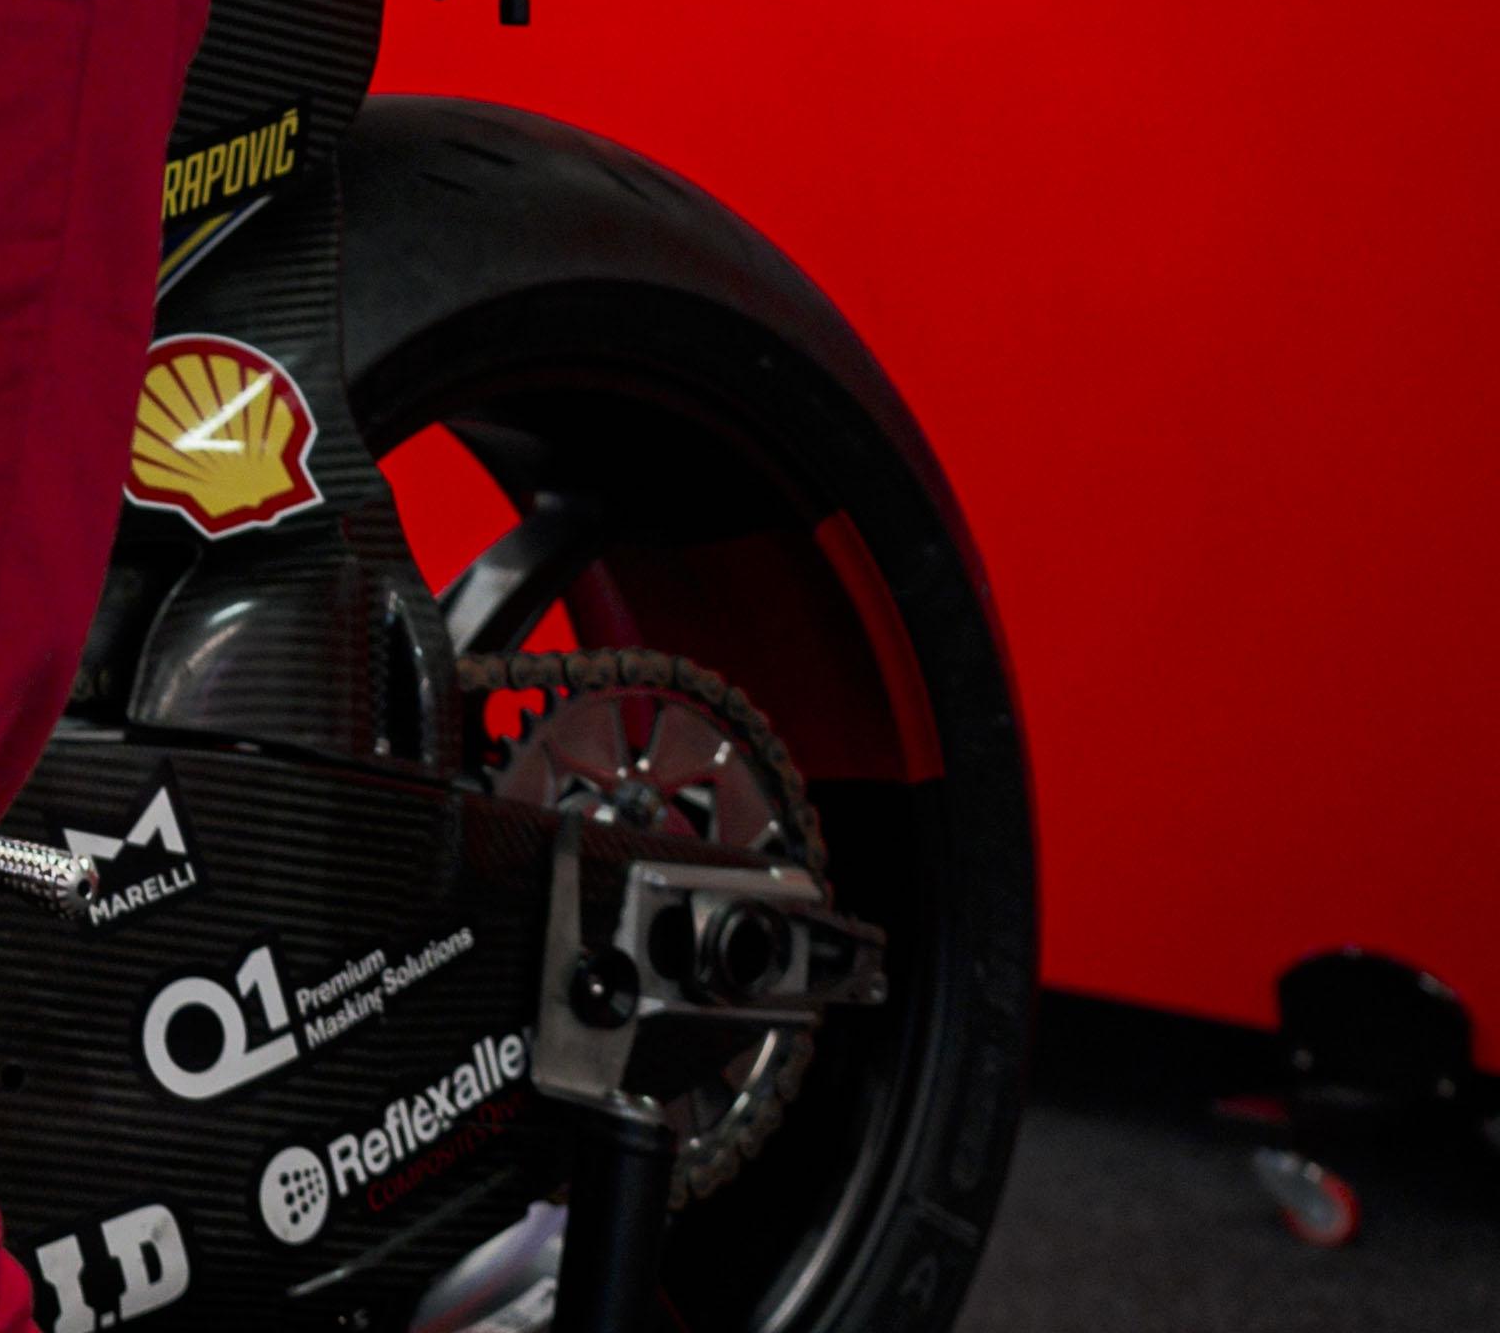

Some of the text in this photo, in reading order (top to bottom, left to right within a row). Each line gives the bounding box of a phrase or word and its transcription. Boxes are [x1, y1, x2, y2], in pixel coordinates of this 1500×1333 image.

[162, 106, 300, 220] RAPOVIČ
[88, 862, 197, 924] MARELLI
[295, 949, 386, 1017] Premium
[381, 927, 474, 995] Solutions
[142, 945, 299, 1101] Q1
[327, 1029, 529, 1196] Reflexalle
